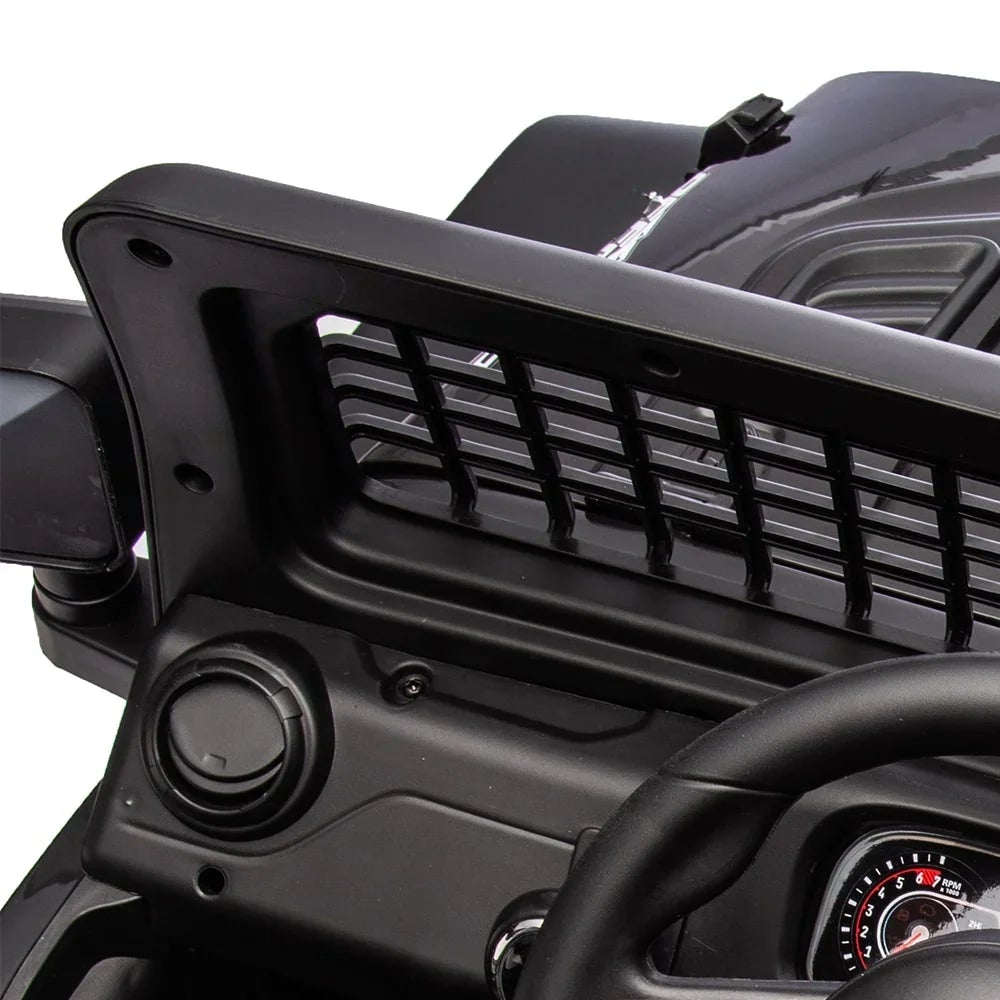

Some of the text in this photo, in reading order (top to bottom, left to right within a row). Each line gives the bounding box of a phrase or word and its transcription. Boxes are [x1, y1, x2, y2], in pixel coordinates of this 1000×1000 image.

[895, 876, 905, 889] 5
[916, 872, 924, 884] 6
[932, 876, 941, 888] 7
[941, 878, 962, 890] RPM
[877, 887, 885, 899] 4
[946, 888, 960, 897] 1000
[865, 904, 874, 917] 3
[860, 926, 869, 938] 2
[863, 946, 873, 958] 1
